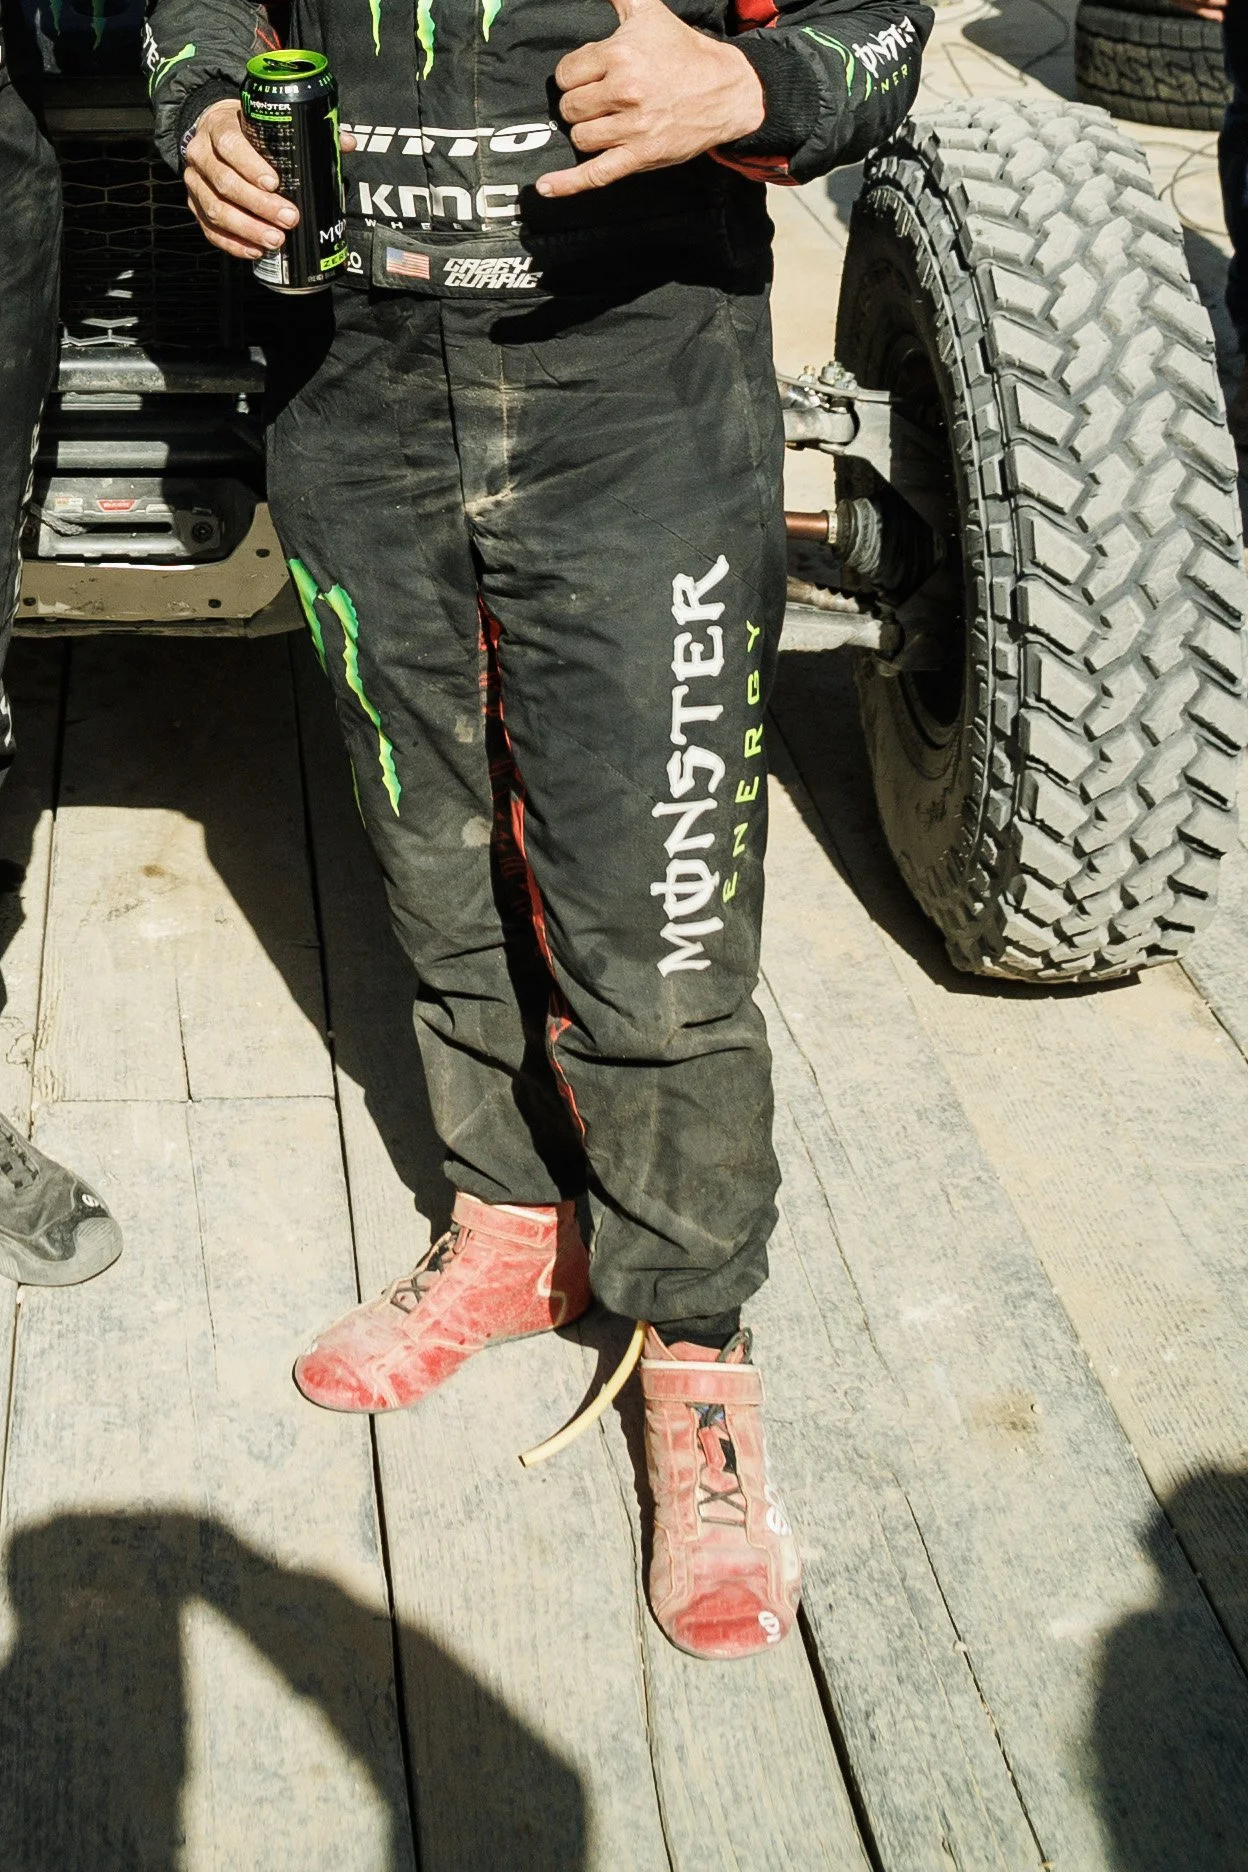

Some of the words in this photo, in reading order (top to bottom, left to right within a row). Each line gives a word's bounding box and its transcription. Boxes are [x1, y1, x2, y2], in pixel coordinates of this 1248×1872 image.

[358, 181, 521, 221] KMC
[322, 248, 348, 269] ZER
[444, 271, 544, 289] CURRIE
[650, 554, 730, 977] MONSTER
[721, 619, 763, 904] ENERGY
